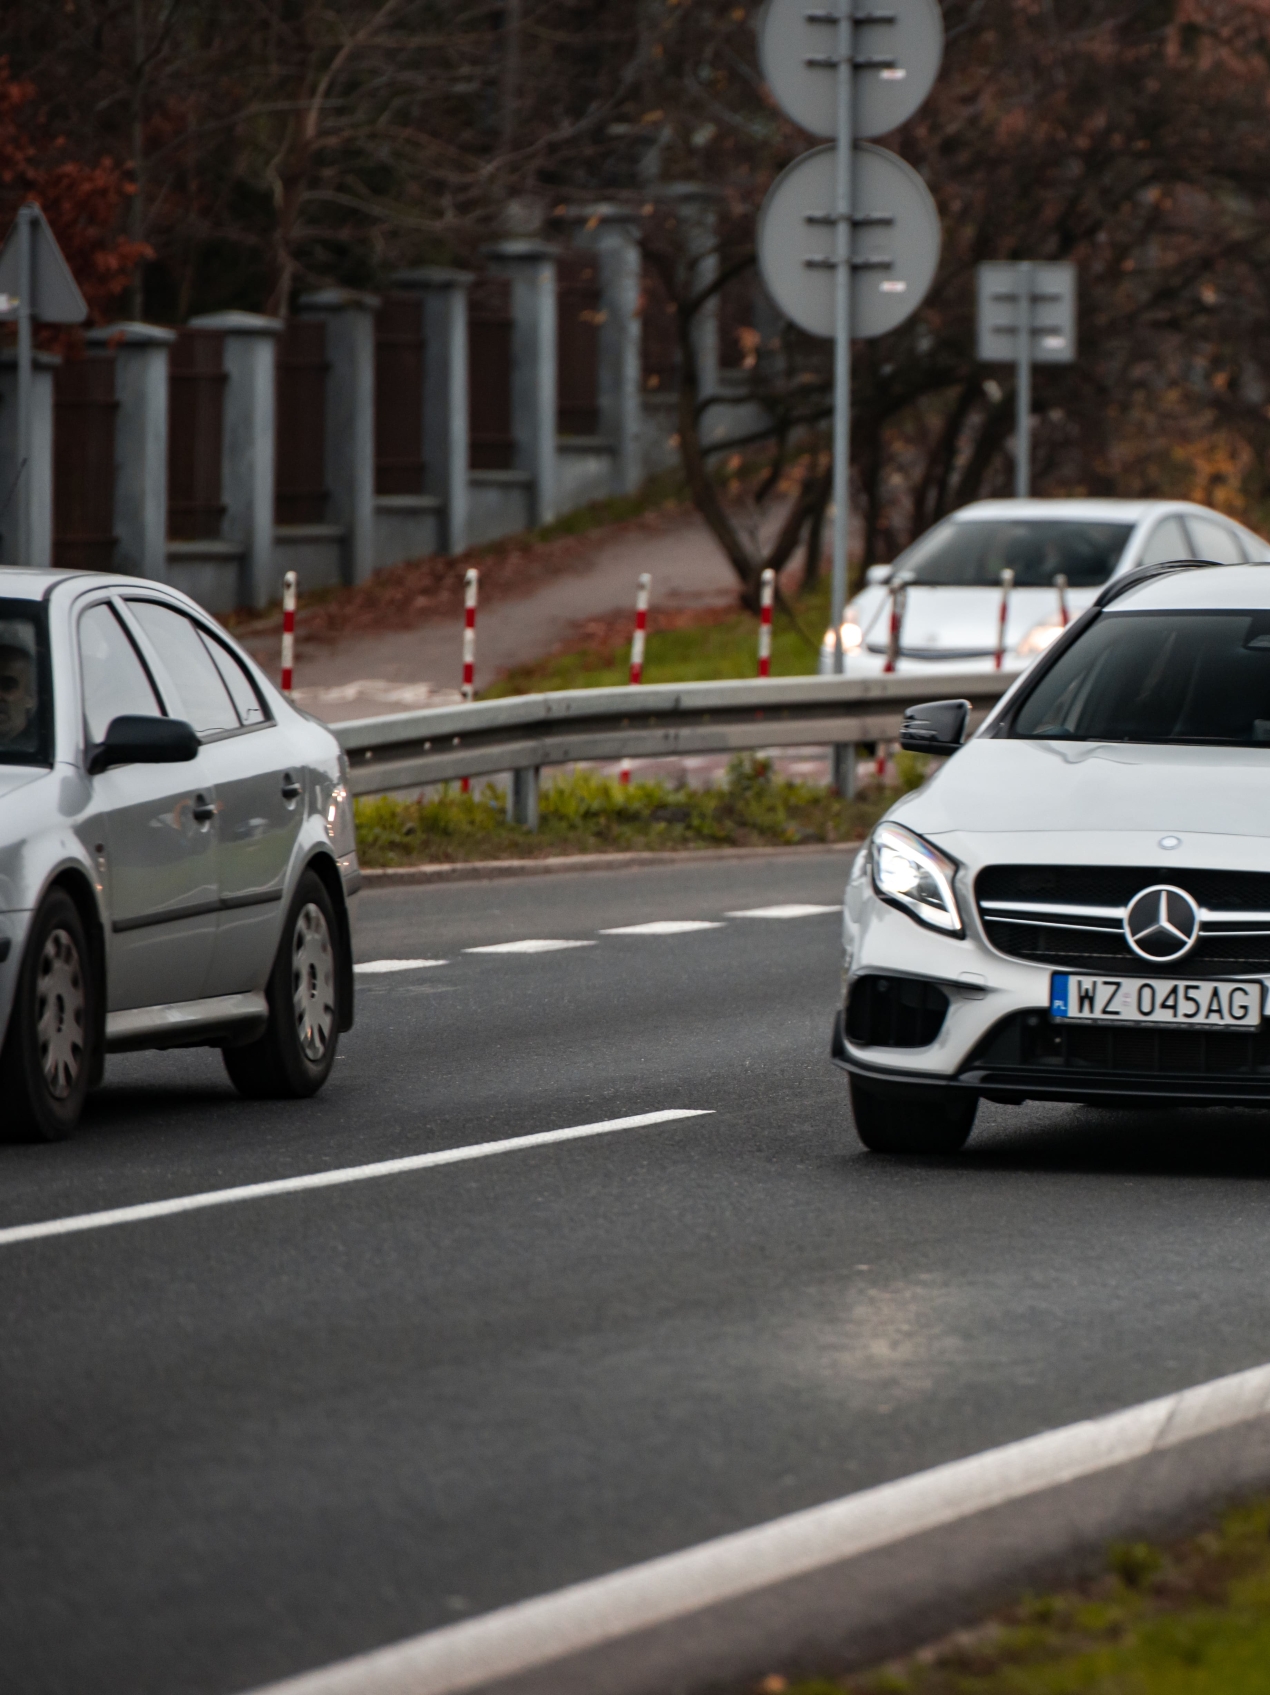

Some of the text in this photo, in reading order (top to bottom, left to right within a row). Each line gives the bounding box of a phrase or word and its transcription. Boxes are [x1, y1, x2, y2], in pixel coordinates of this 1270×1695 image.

[1053, 999, 1066, 1010] PL
[1077, 979, 1250, 1021] WZ 045AG
